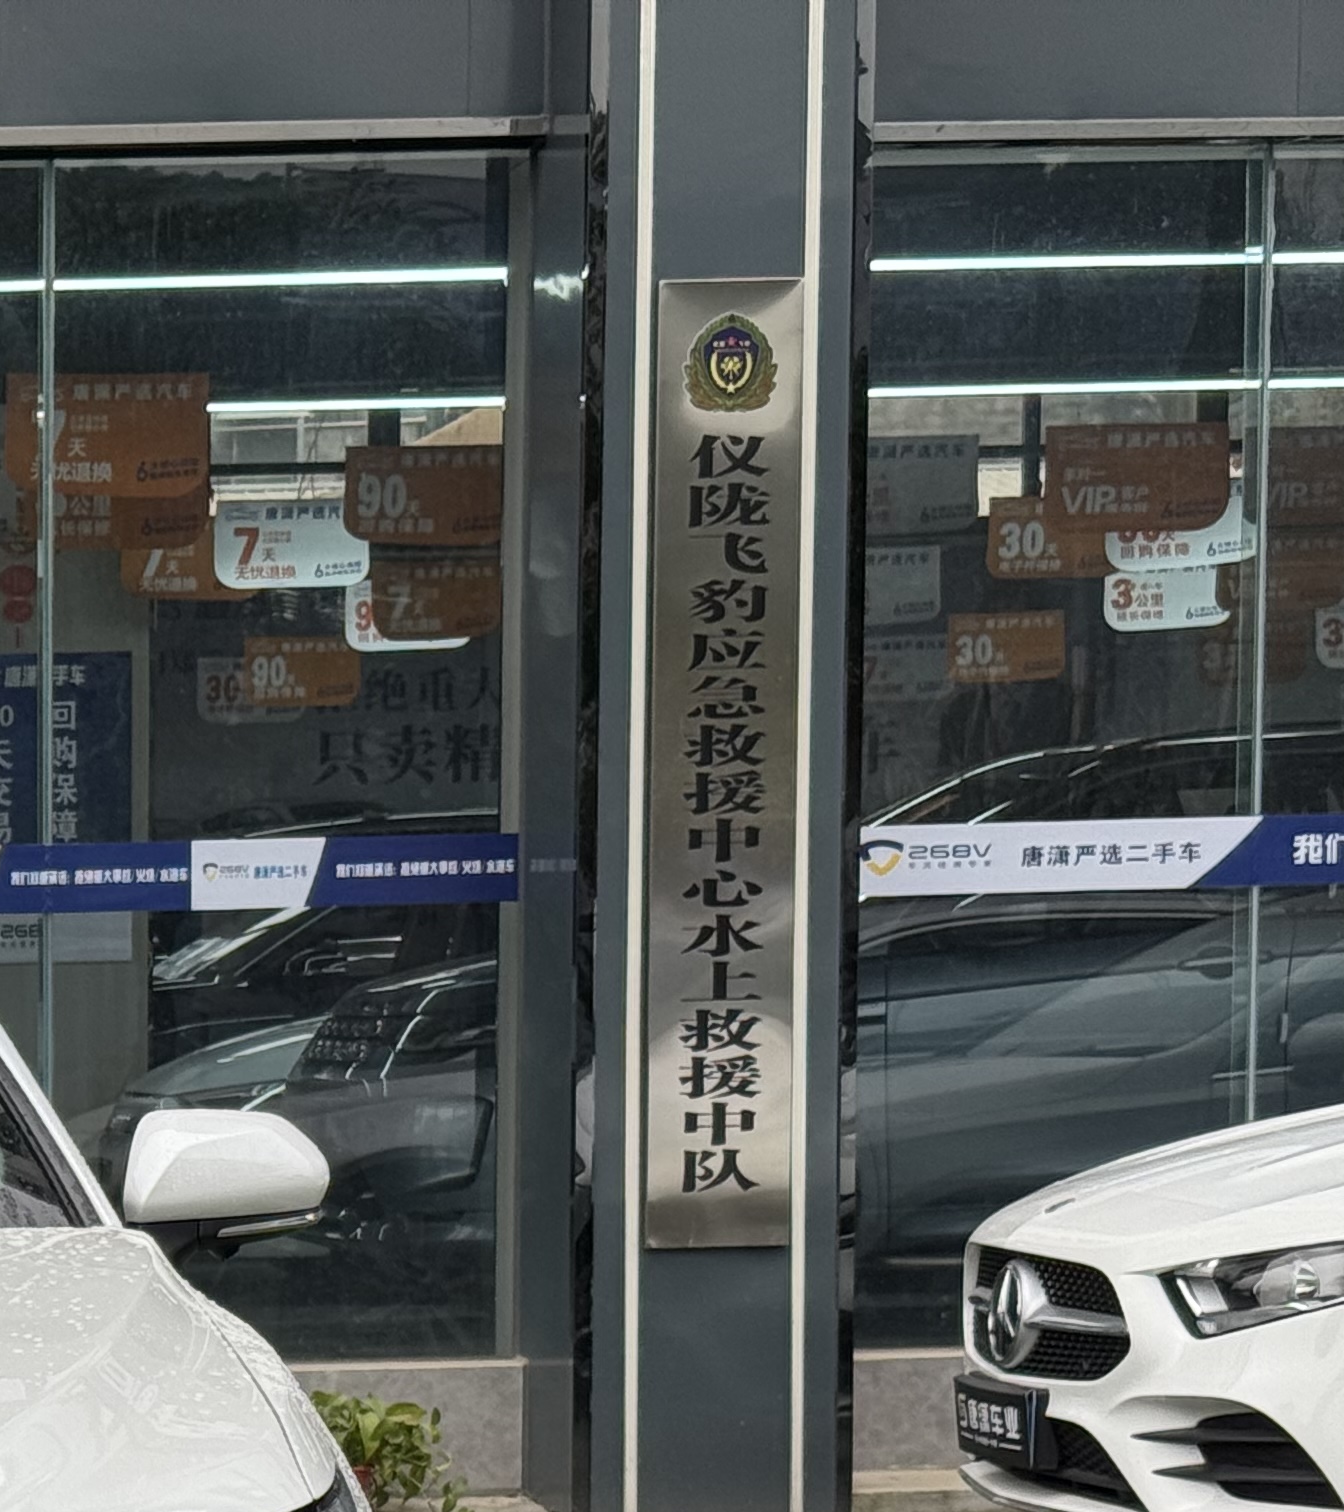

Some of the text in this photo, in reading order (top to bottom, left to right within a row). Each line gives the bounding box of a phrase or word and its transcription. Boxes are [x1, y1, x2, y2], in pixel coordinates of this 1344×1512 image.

[679, 434, 773, 1192] 仪陇飞豹应急救援中心水上救援中队
[908, 842, 1202, 868] 268V 唐潇严选二手车
